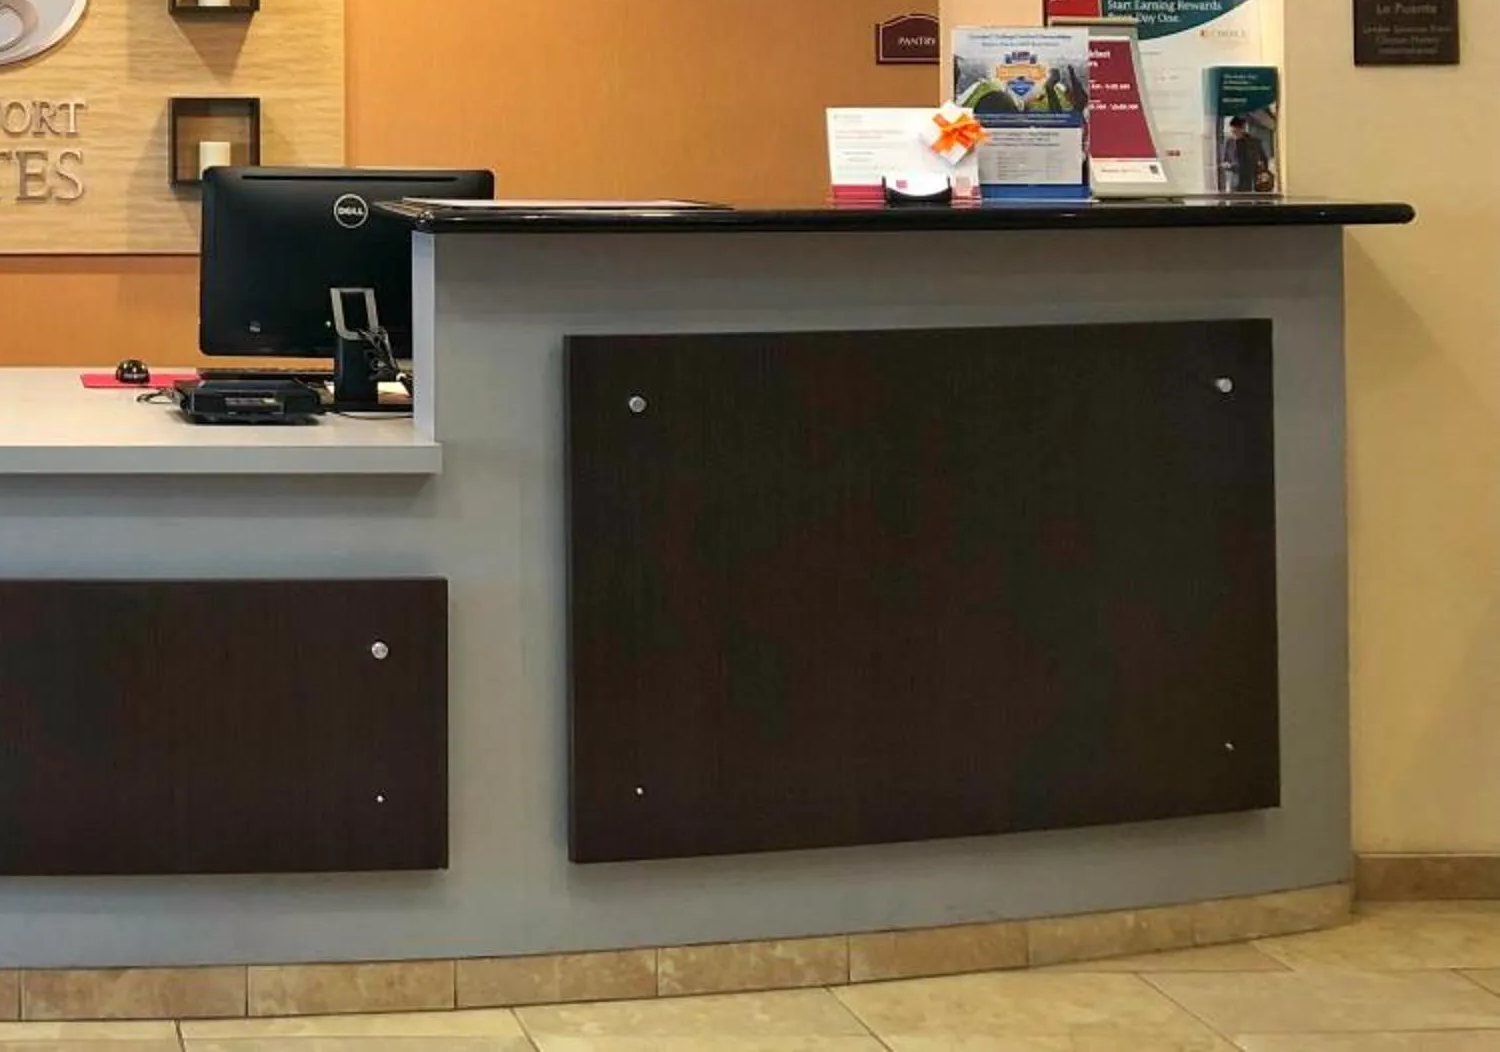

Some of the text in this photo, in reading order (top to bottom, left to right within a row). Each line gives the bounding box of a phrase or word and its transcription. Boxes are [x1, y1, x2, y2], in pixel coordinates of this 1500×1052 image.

[1107, 0, 1222, 13] Start Earning Rewards
[338, 206, 363, 215] DELL
